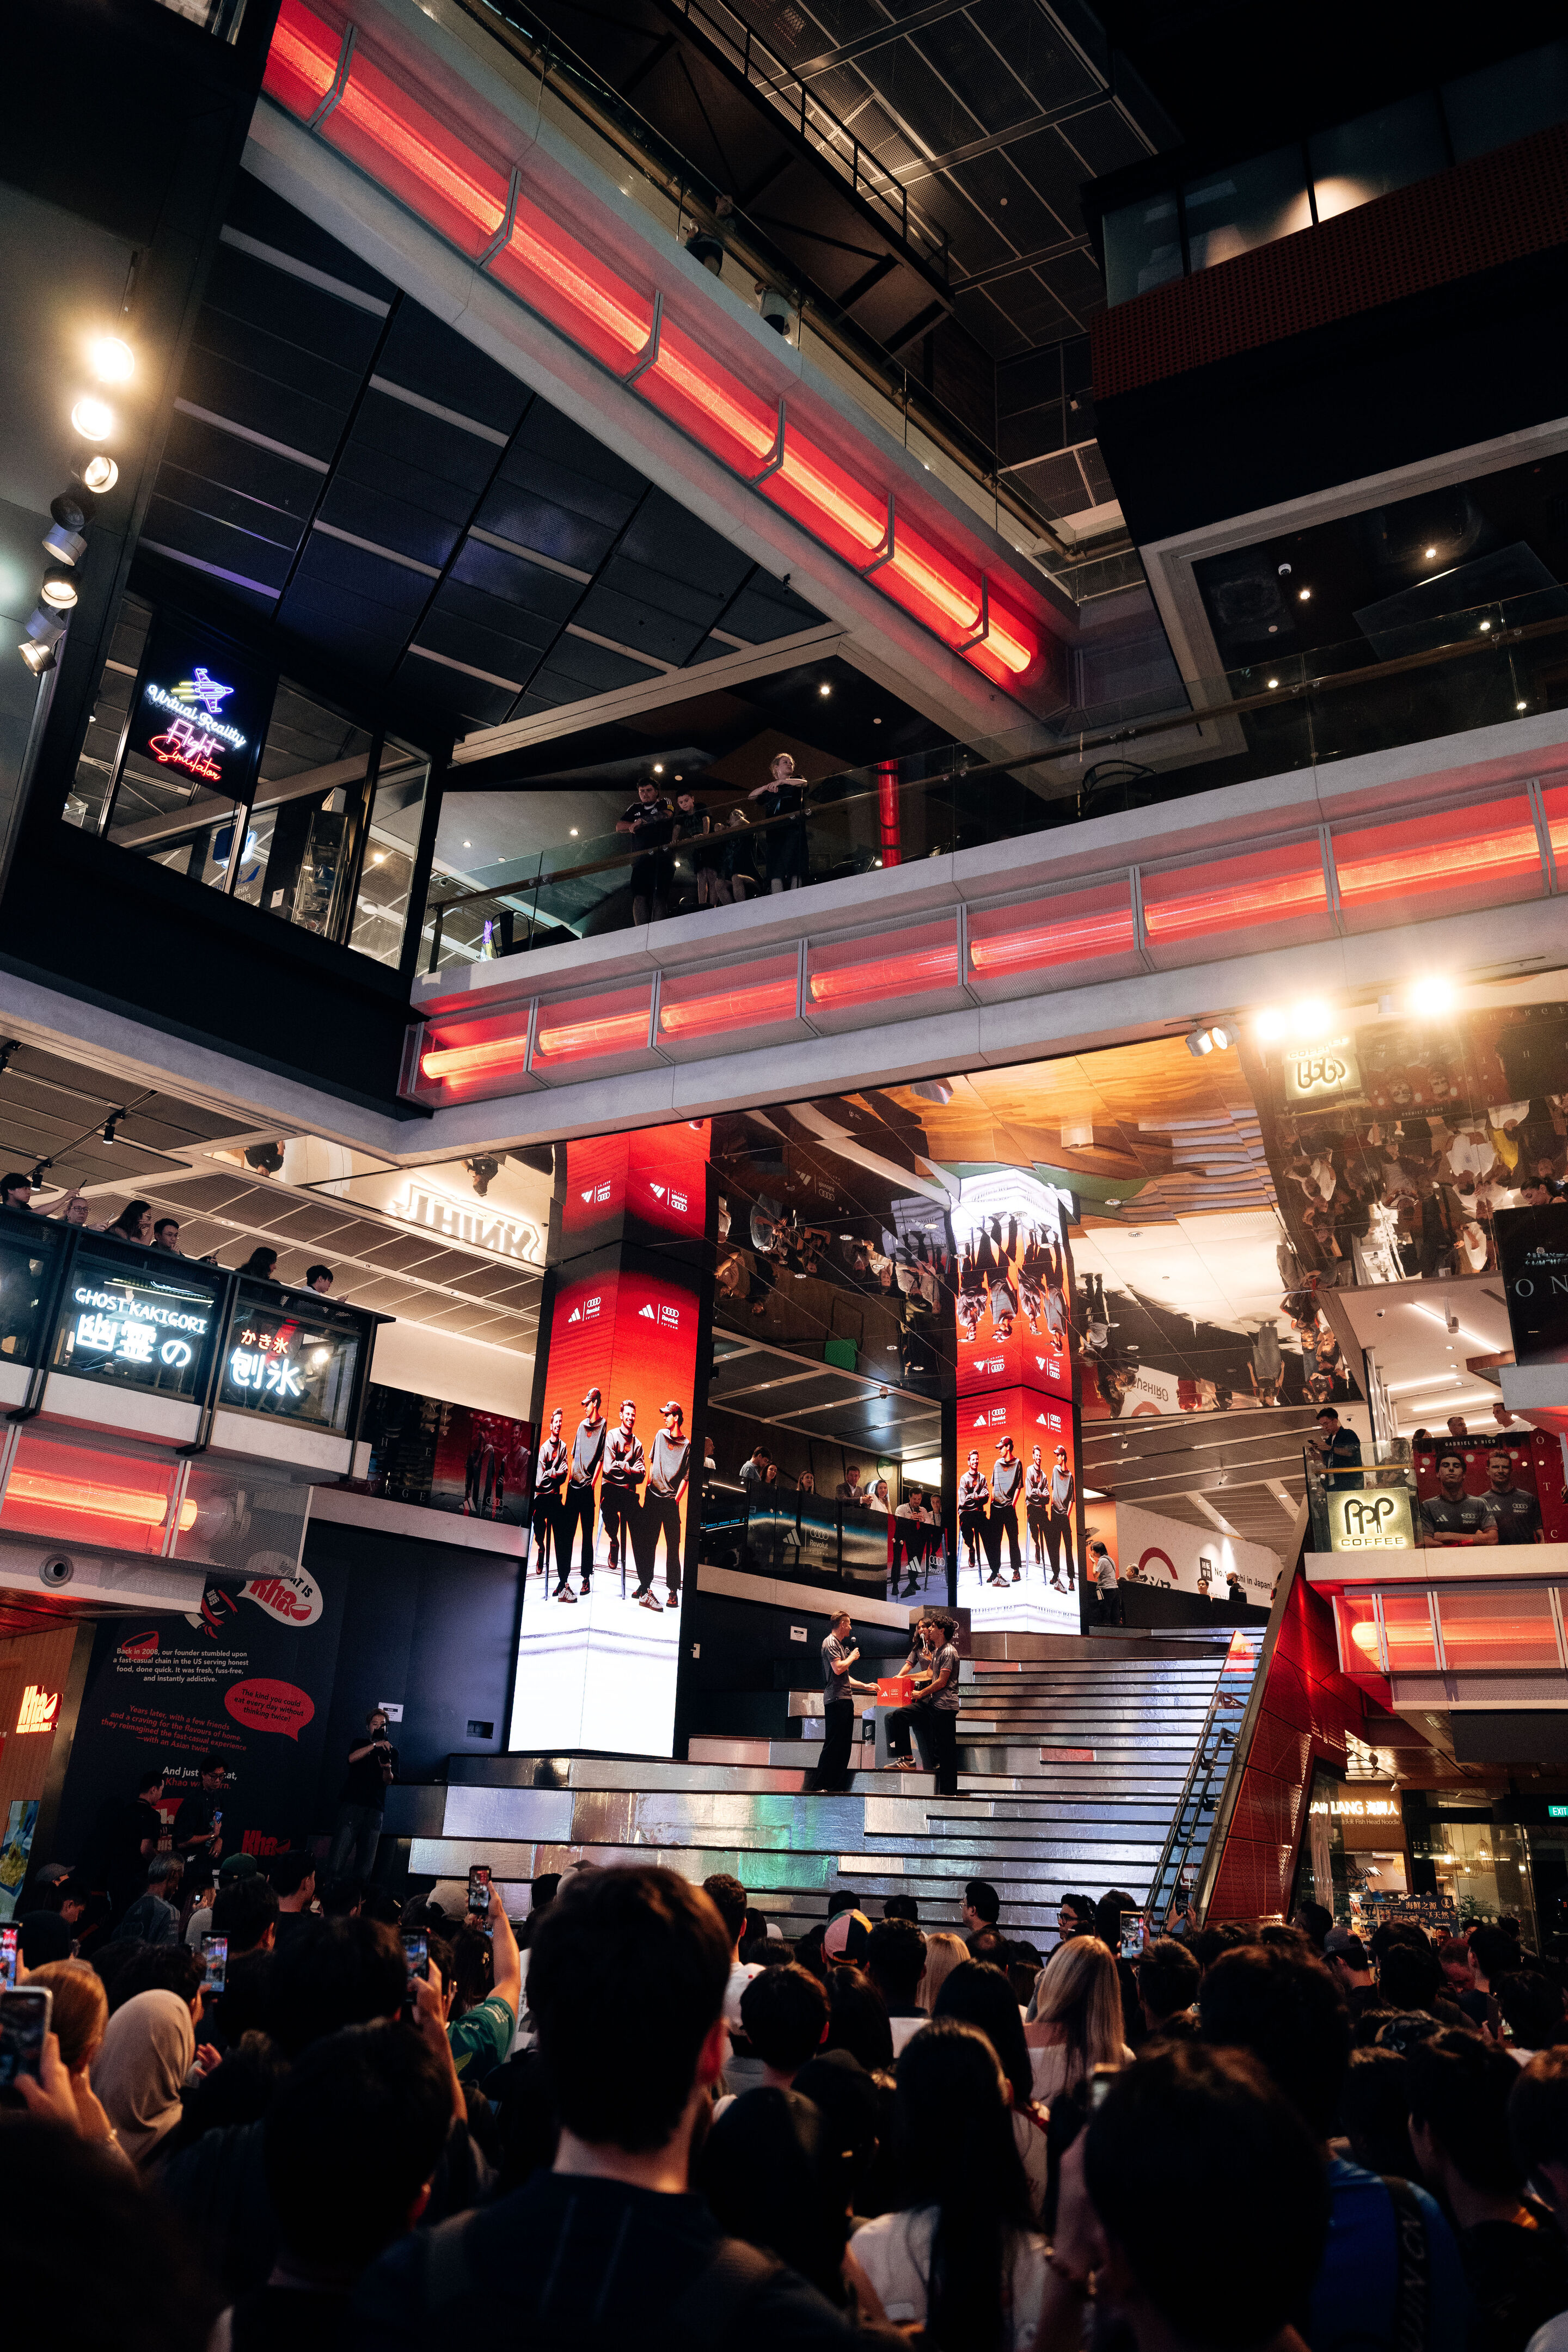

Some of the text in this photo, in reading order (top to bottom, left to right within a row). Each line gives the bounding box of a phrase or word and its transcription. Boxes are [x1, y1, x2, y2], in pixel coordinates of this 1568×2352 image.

[148, 684, 247, 747] Virtual Reality
[167, 718, 225, 757] Flight
[150, 735, 222, 781] Simulator
[75, 1287, 207, 1334] GHOST KAKIGORI
[661, 1314, 678, 1325] Revolut
[241, 1328, 289, 1354] かき氷
[810, 1540, 828, 1549] Revolut
[1341, 1537, 1404, 1547] COFFEE
[1247, 1576, 1253, 1585] in
[1254, 1578, 1272, 1590] Japan!
[301, 1585, 313, 1598] IS
[157, 1675, 185, 1683] instantly
[255, 1691, 269, 1700] kind
[243, 1707, 291, 1722] thinking twice!
[247, 1700, 265, 1709] every
[266, 1702, 278, 1712] day
[280, 1706, 303, 1716] without
[130, 1704, 148, 1715] Years
[150, 1708, 167, 1719] later,
[192, 1717, 205, 1725] few
[207, 1720, 230, 1730] friends
[101, 1718, 247, 1751] they reimagined the fast-casual experience
[132, 1716, 157, 1727] craving
[160, 1719, 170, 1728] for
[171, 1722, 183, 1730] the
[184, 1724, 212, 1736] flavours
[222, 1731, 242, 1742] home,
[170, 1740, 189, 1749] Asian
[191, 1744, 210, 1753] twist.
[162, 1766, 181, 1775] And
[181, 1767, 199, 1778] just
[165, 1777, 188, 1786] Khao
[1552, 1807, 1567, 1816] EXIT
